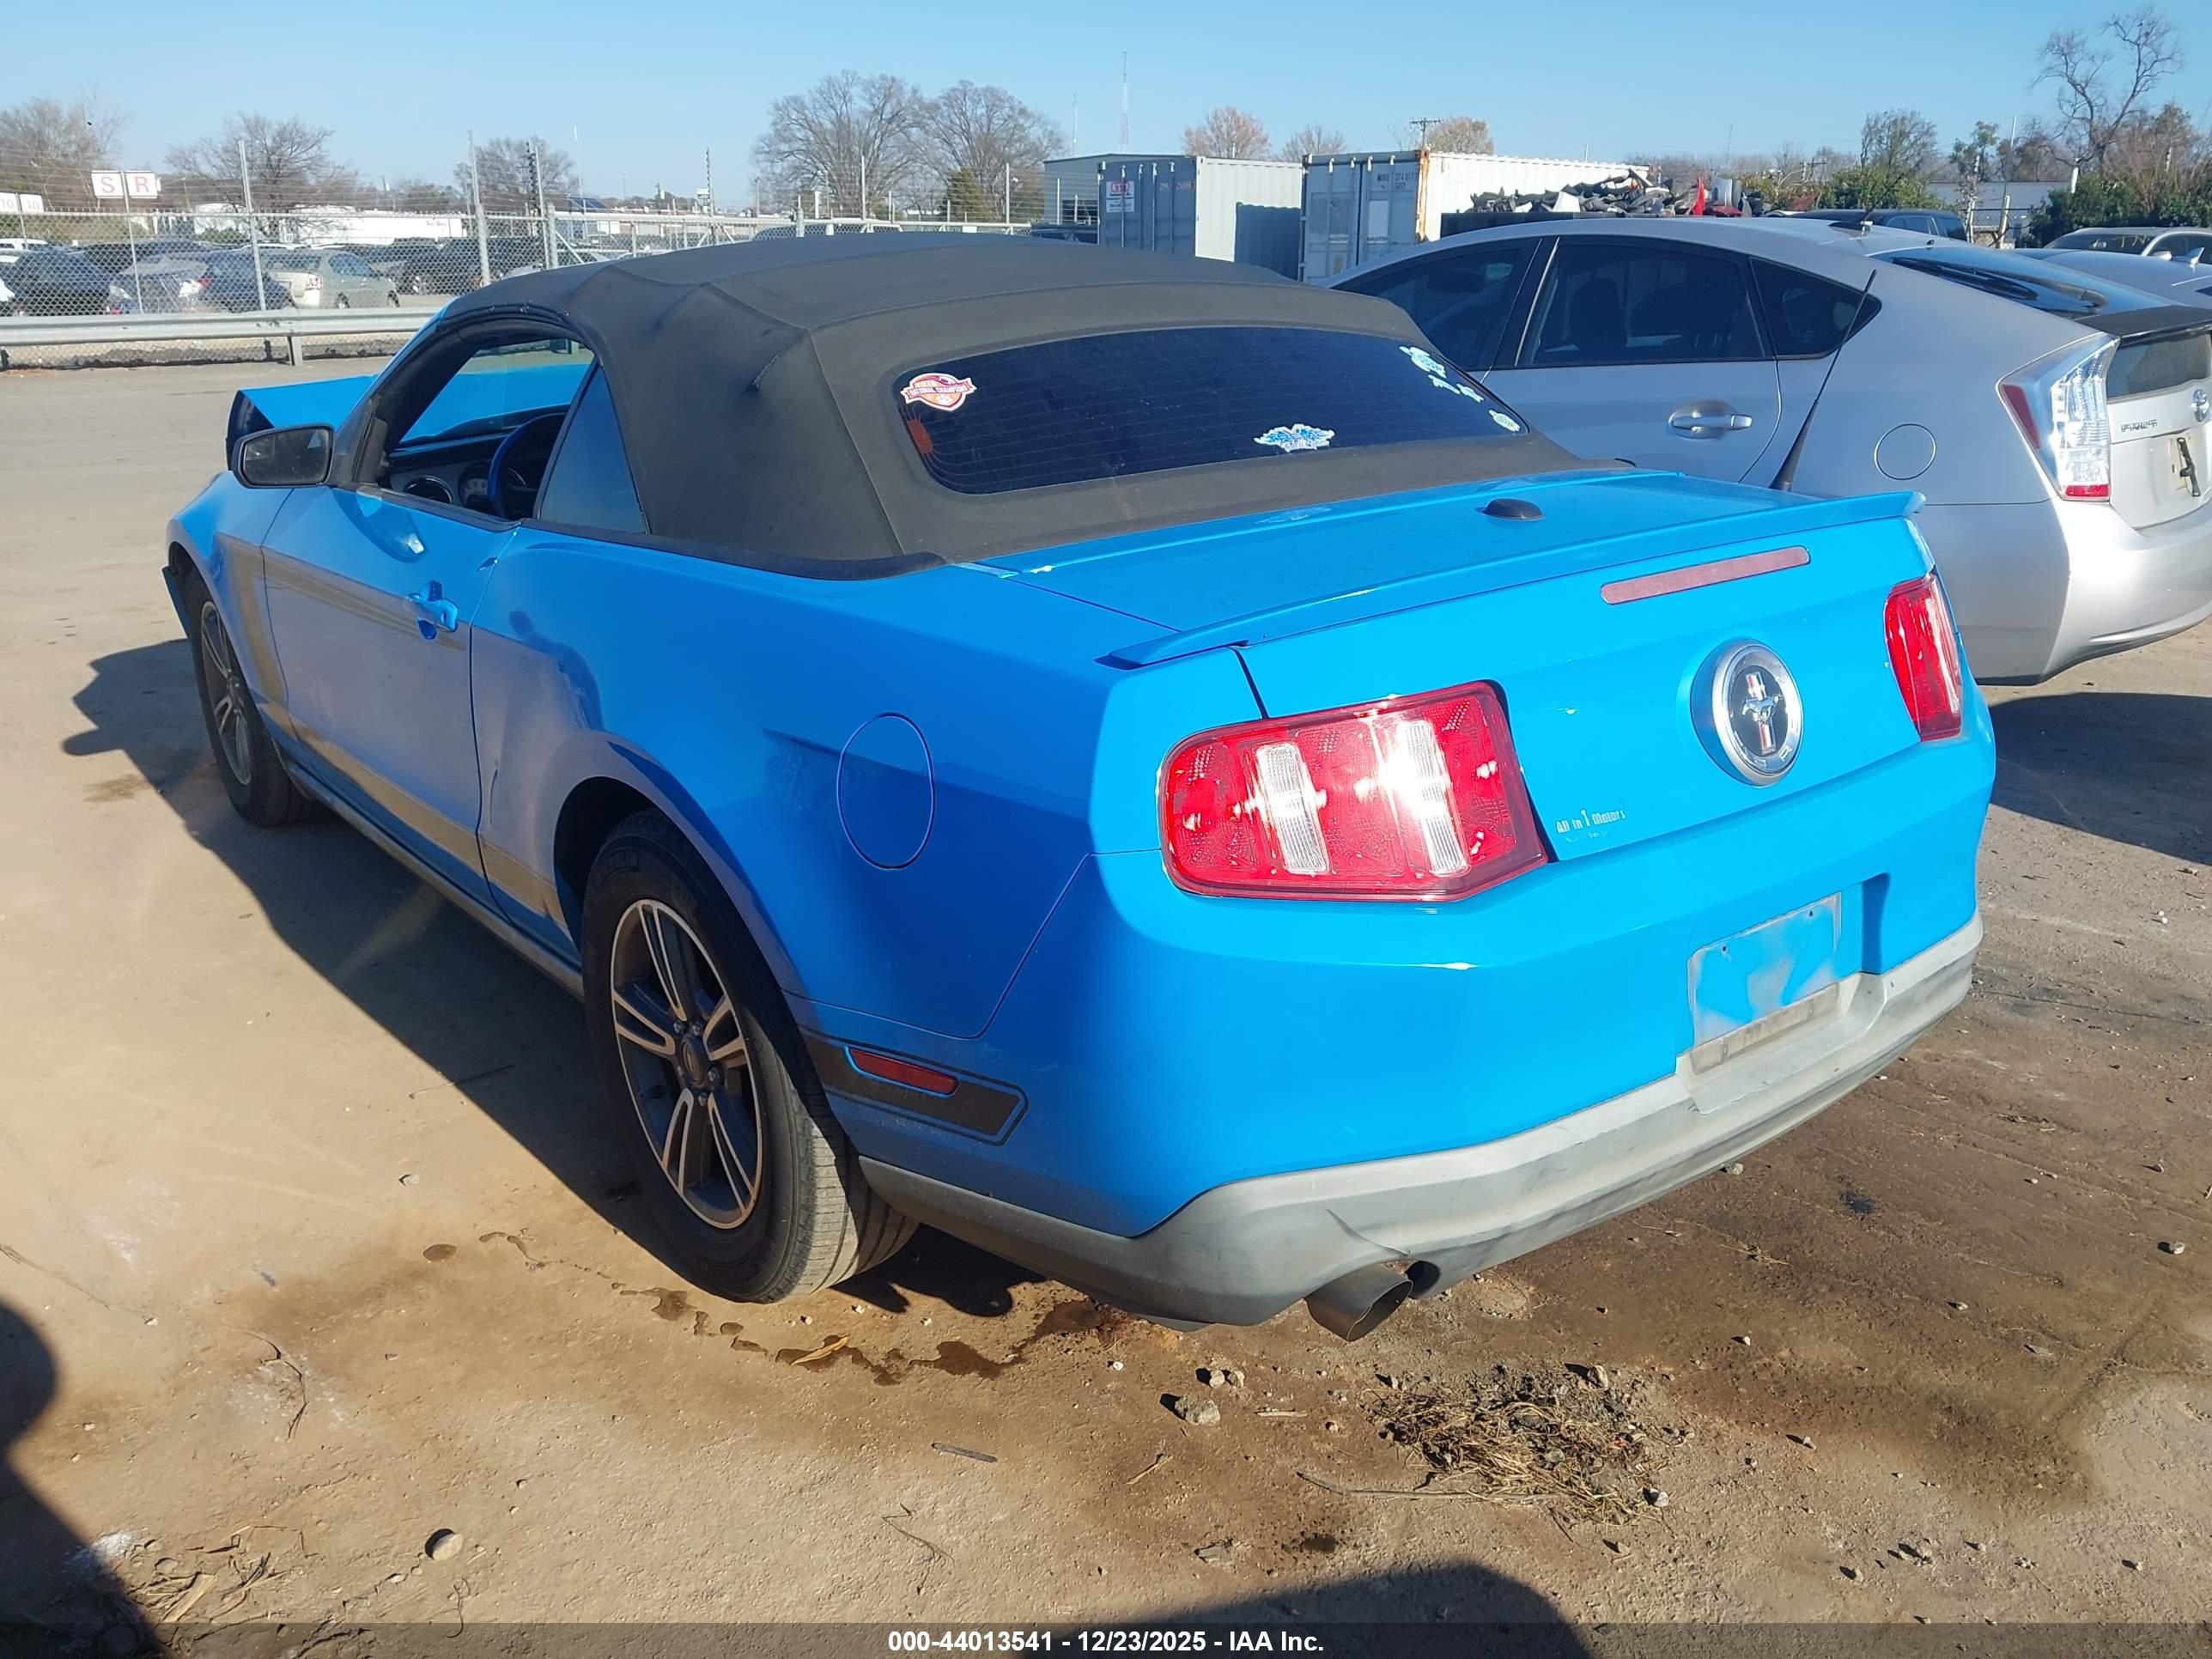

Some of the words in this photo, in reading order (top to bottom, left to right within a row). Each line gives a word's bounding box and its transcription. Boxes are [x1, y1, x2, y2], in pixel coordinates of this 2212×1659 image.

[100, 176, 115, 193] S
[134, 176, 149, 193] R
[1556, 819, 1571, 834] All
[1580, 809, 1590, 827] 1
[1591, 810, 1626, 825] Motors
